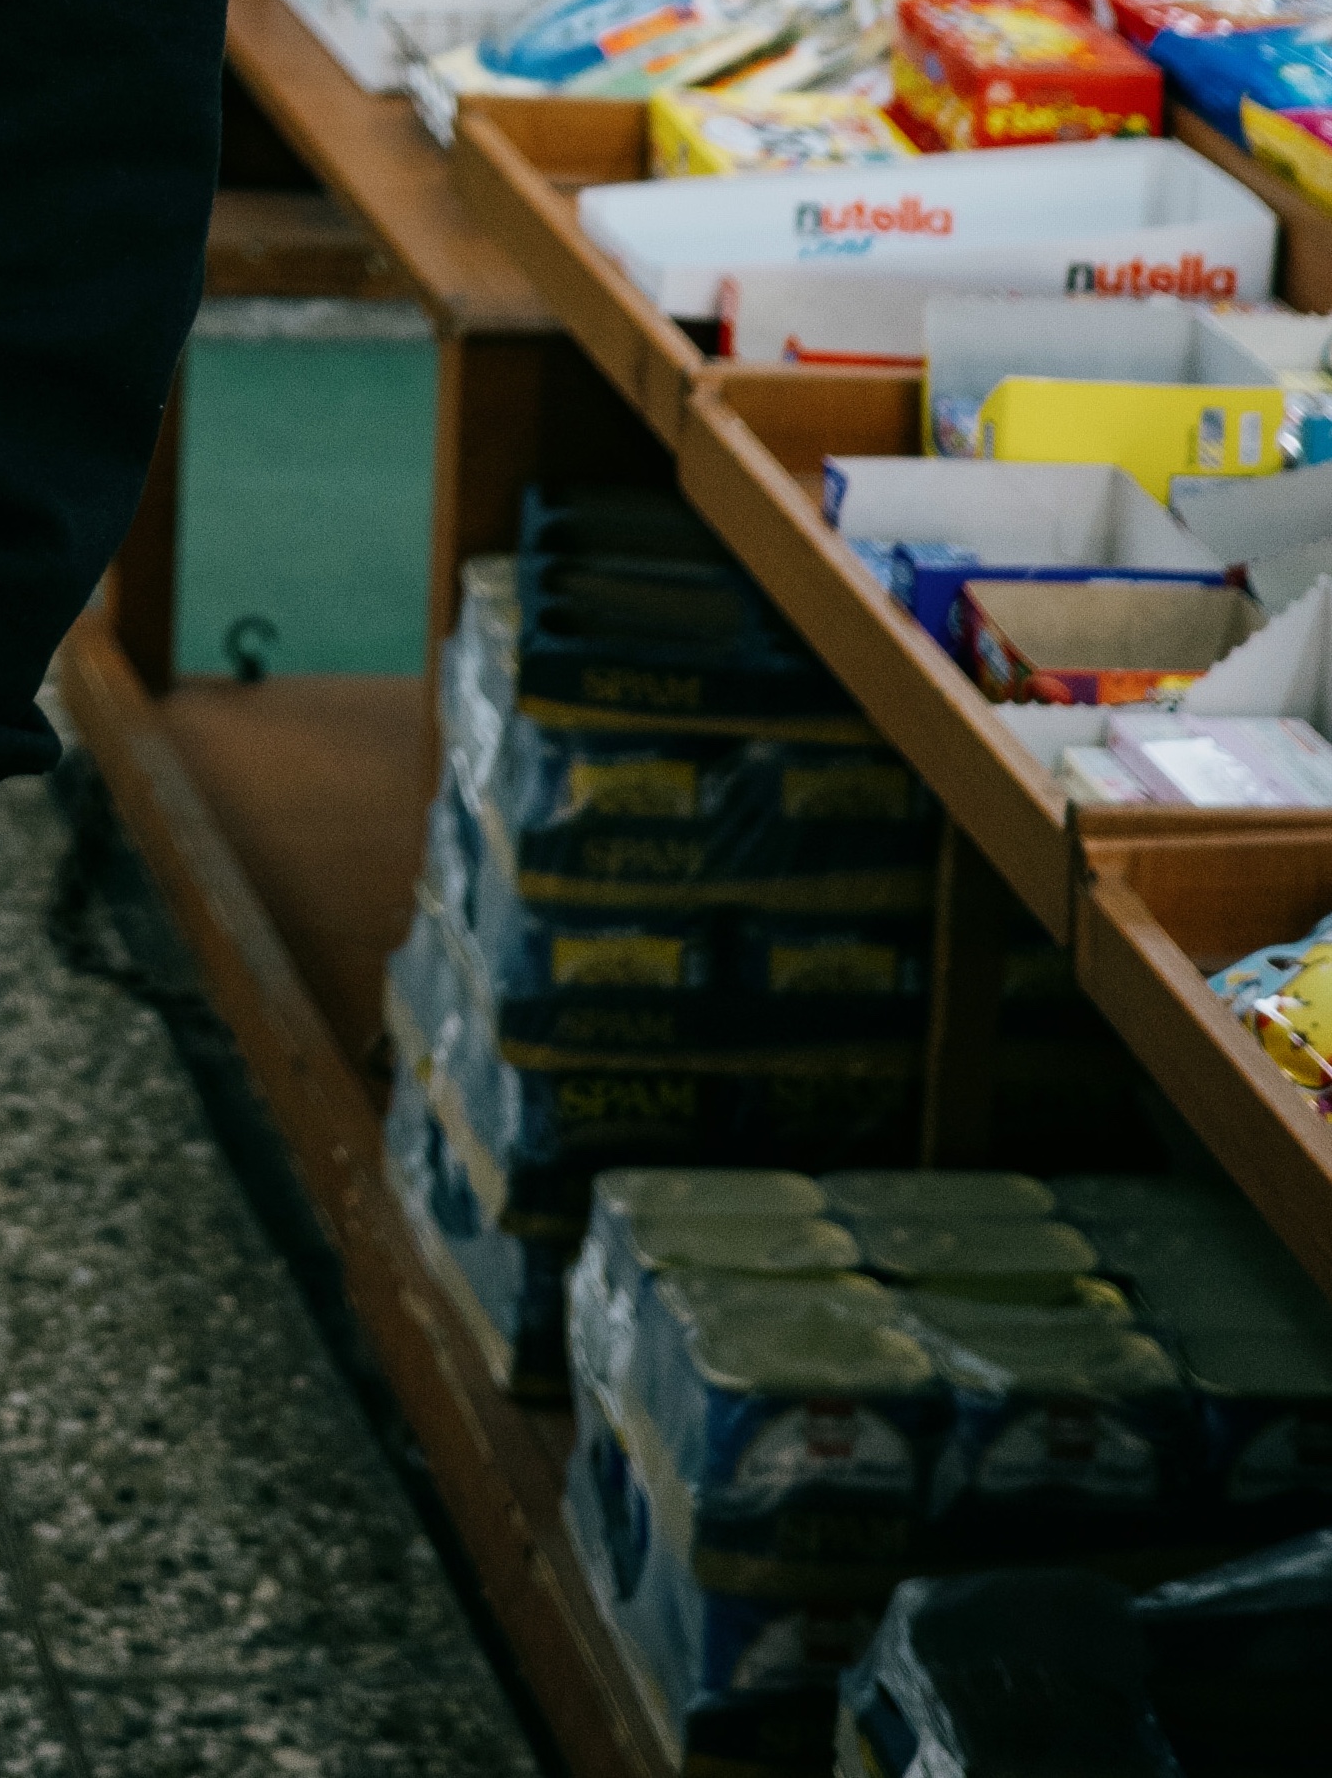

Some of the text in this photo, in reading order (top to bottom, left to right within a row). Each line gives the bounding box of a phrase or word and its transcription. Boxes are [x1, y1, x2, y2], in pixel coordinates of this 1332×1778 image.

[795, 194, 954, 237] nutella
[1066, 252, 1237, 298] nutella
[581, 667, 702, 709] SPAM
[558, 1078, 697, 1118] SPAM
